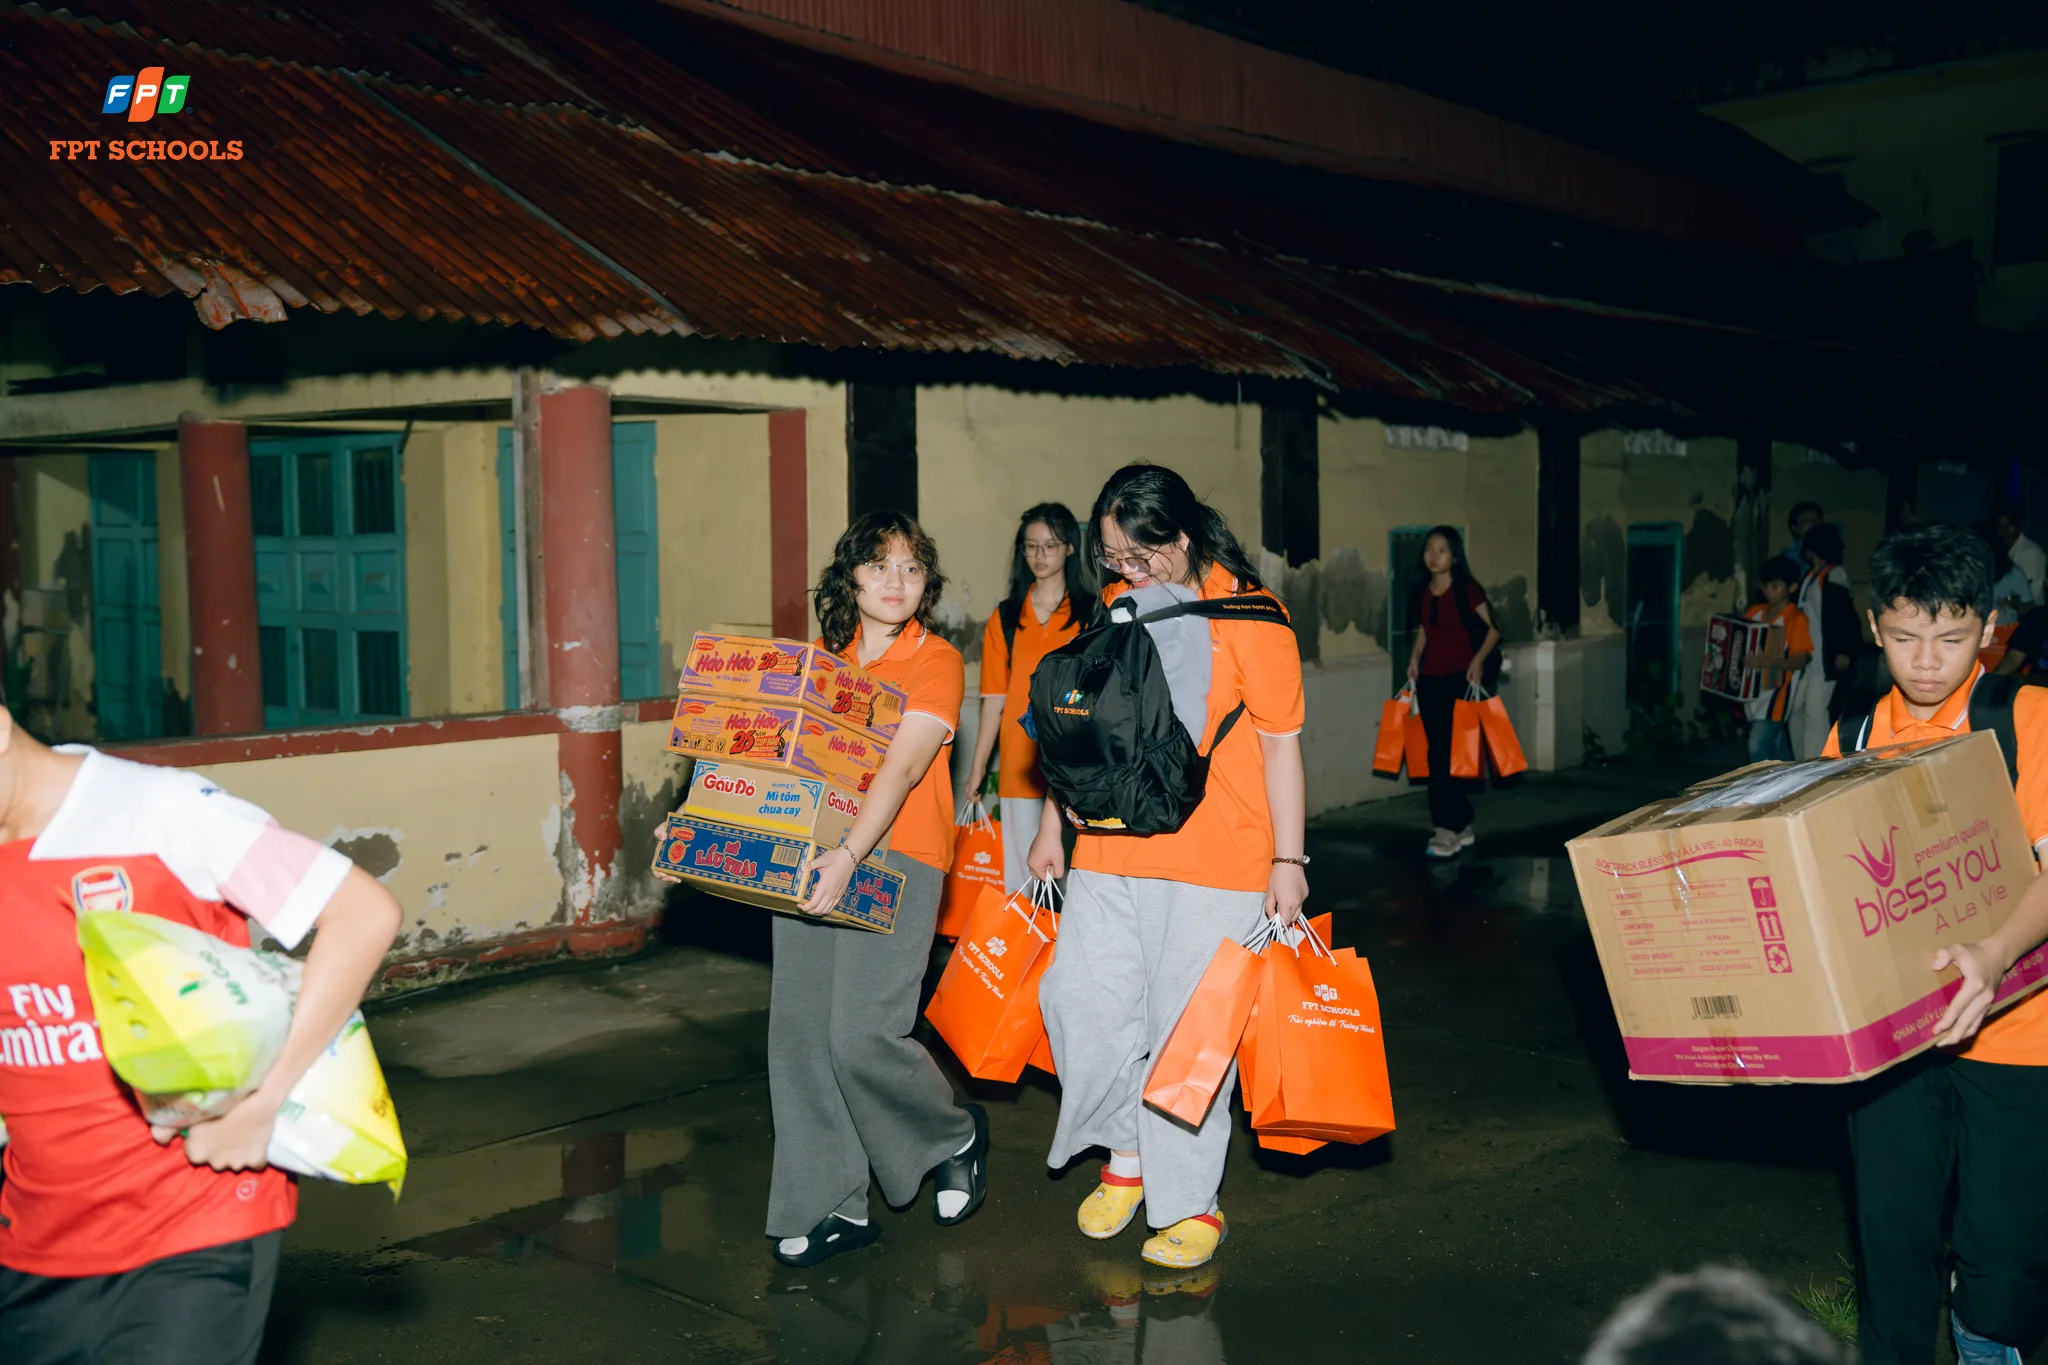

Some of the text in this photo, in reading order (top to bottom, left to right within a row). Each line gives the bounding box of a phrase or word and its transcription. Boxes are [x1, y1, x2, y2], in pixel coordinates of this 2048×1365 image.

[695, 650, 724, 673] Hảo
[725, 650, 757, 673] Hảo
[758, 651, 779, 670] 26
[834, 670, 873, 696] Hảo Hảo
[832, 690, 854, 714] 26
[1053, 706, 1089, 716] FPT SCHOOLS
[725, 711, 752, 730] Hảo
[752, 710, 780, 730] Hảo
[729, 730, 756, 754] 26
[828, 735, 866, 758] Hảo Hảo
[703, 774, 756, 797] Gấu Đỏ
[765, 791, 800, 802] Mì tôm
[758, 803, 801, 817] chua cay
[827, 791, 846, 810] Gấu
[1914, 818, 1990, 868] premium quality
[1596, 858, 1637, 872] SOFTPACK
[1663, 849, 1682, 862] YOU
[1689, 845, 1701, 855] LA
[1700, 840, 1715, 851] VIE
[1734, 838, 1764, 849] PACKS
[1855, 838, 2002, 937] bless YOU
[1934, 884, 2008, 935] À La Vie
[968, 941, 1004, 980] FPT SCHOOLS
[8, 982, 75, 1020] Fly
[1302, 1001, 1360, 1016] FPT SCHOOLS
[0, 1019, 103, 1067] mira
